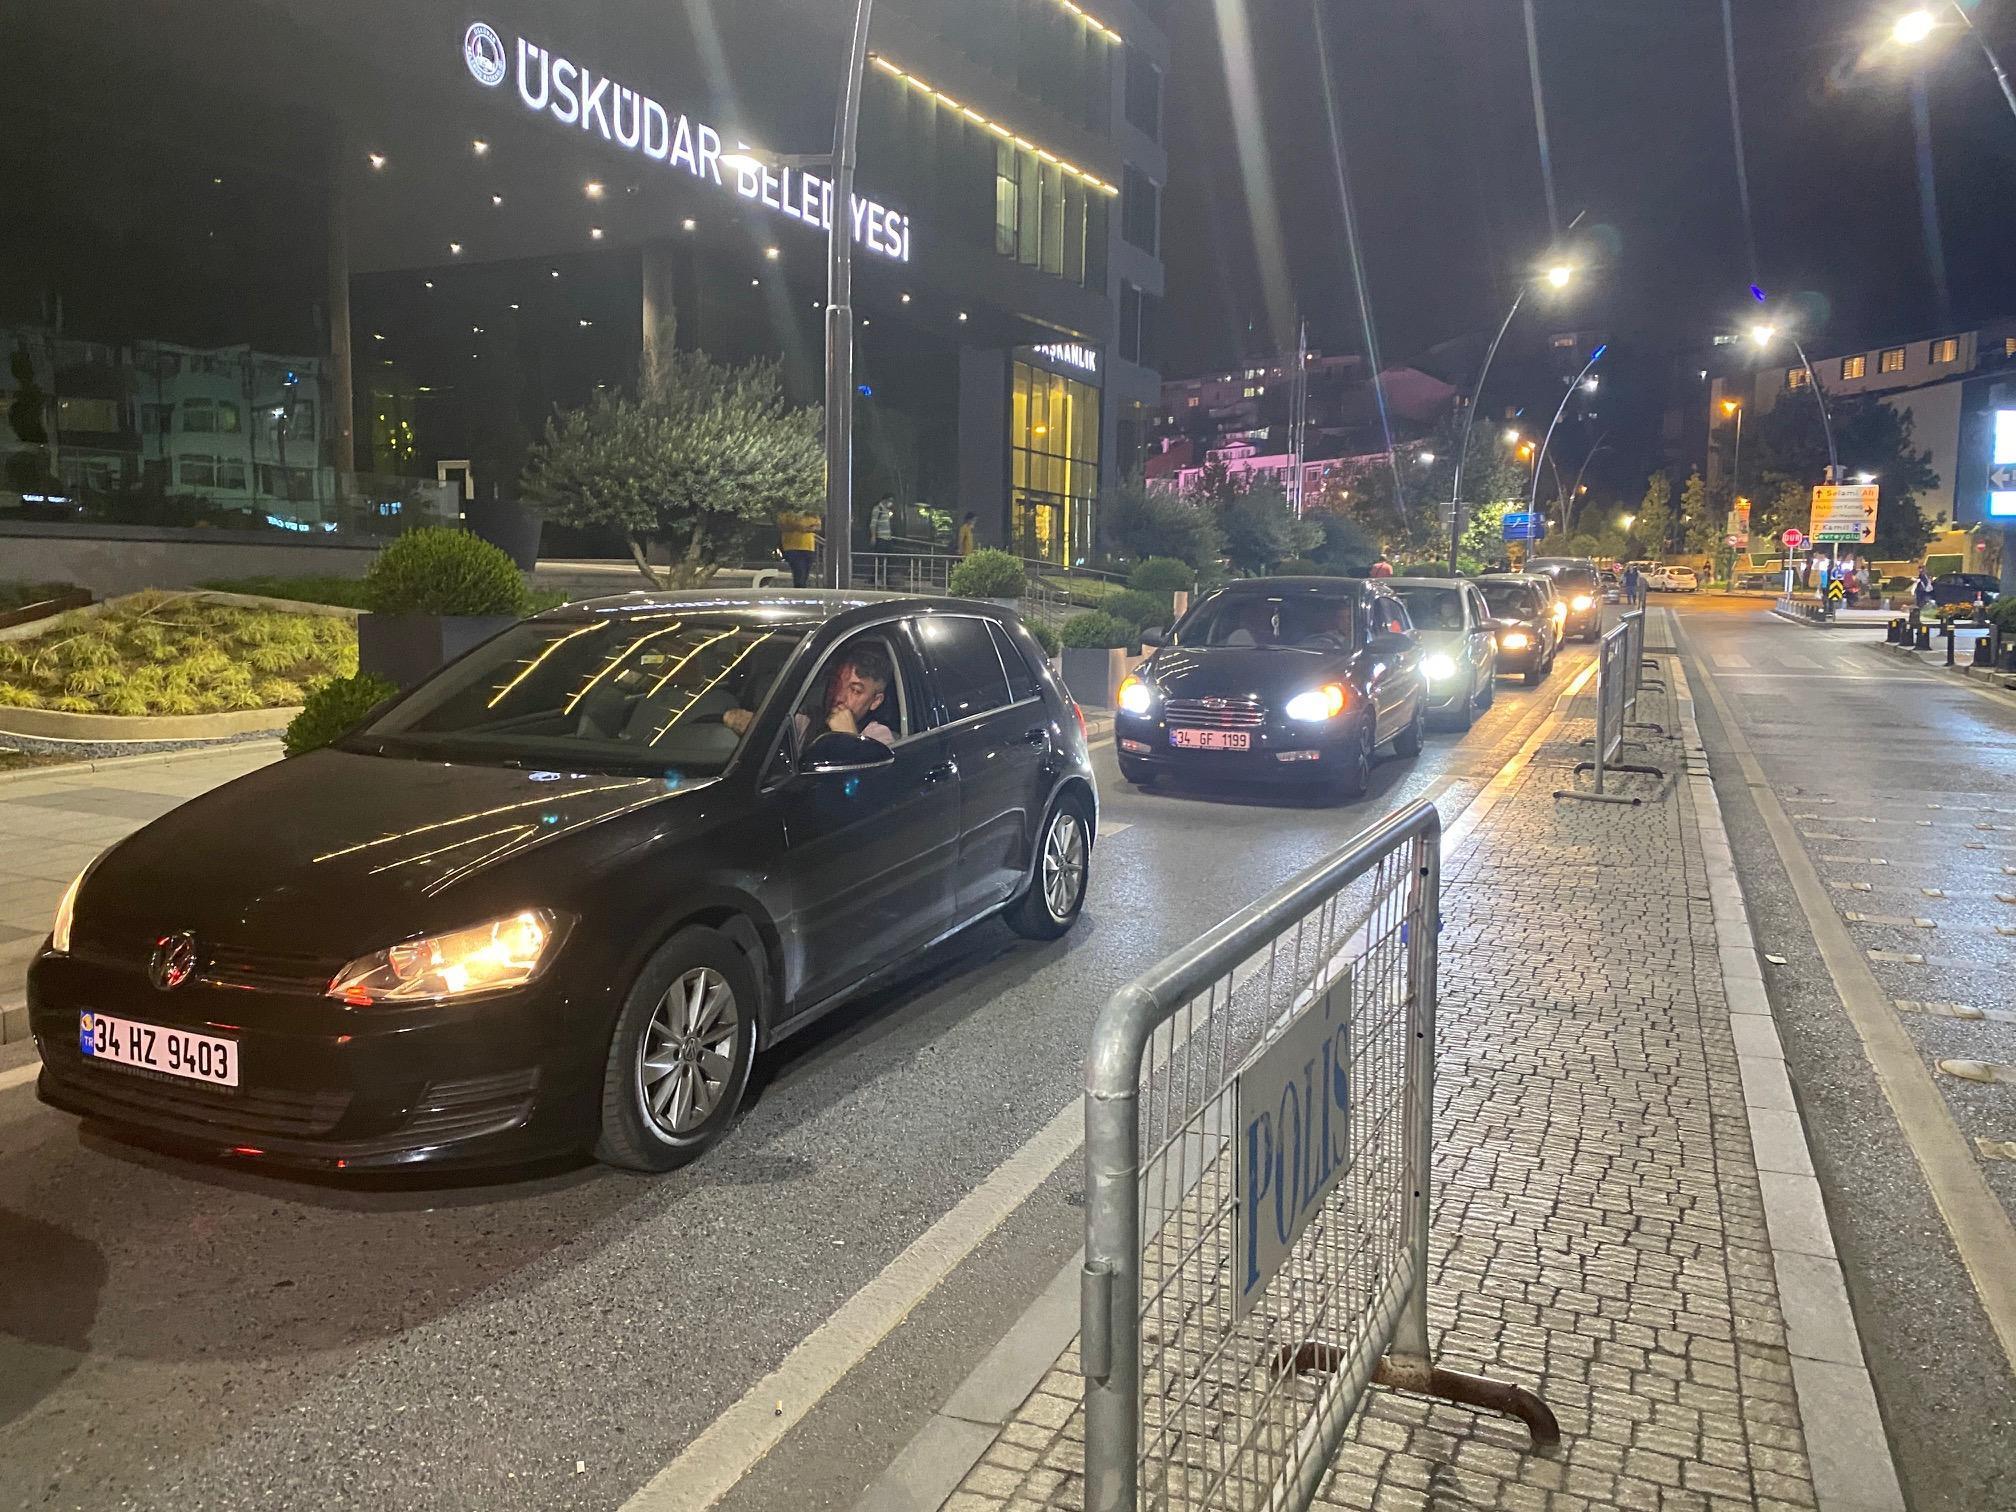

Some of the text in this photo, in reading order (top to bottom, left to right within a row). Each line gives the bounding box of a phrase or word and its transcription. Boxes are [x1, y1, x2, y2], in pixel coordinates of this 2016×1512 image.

[517, 37, 909, 262] ÜSKÜDAR BELEDYESİ
[1177, 731, 1247, 747] 34 GF 1199
[84, 1035, 93, 1047] TR
[95, 1018, 120, 1056] 34
[129, 1026, 157, 1066] HZ
[167, 1035, 228, 1079] 9403
